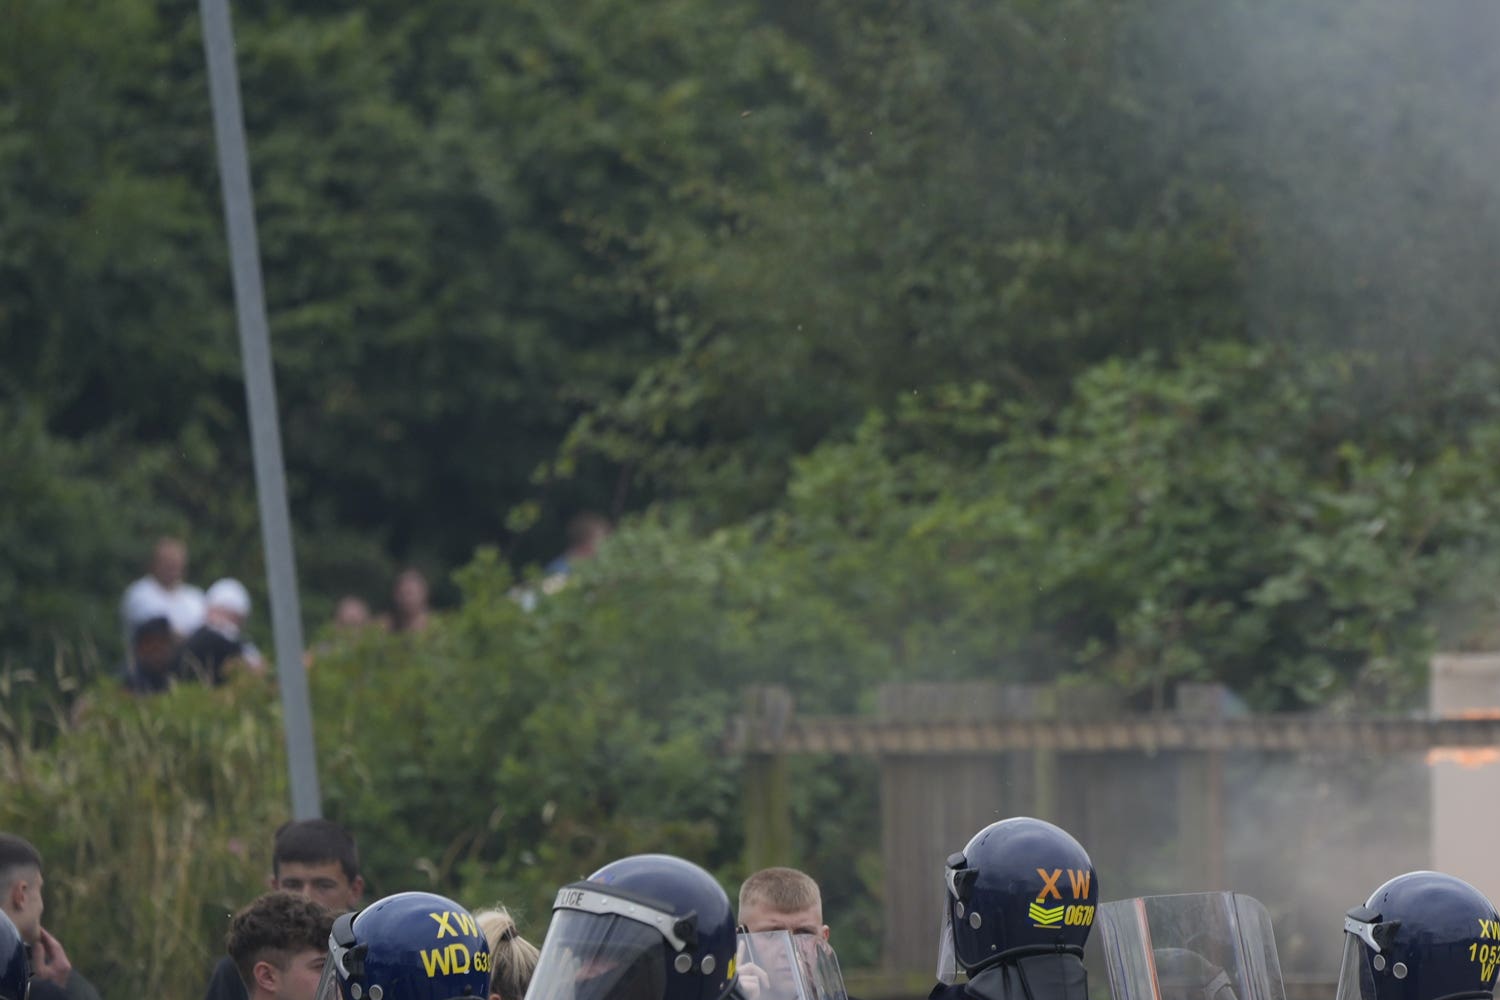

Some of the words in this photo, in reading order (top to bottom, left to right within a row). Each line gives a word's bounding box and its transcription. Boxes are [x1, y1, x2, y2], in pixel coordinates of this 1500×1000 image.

[429, 911, 479, 939] XW
[1478, 918, 1500, 940] XW
[420, 943, 471, 978] WD
